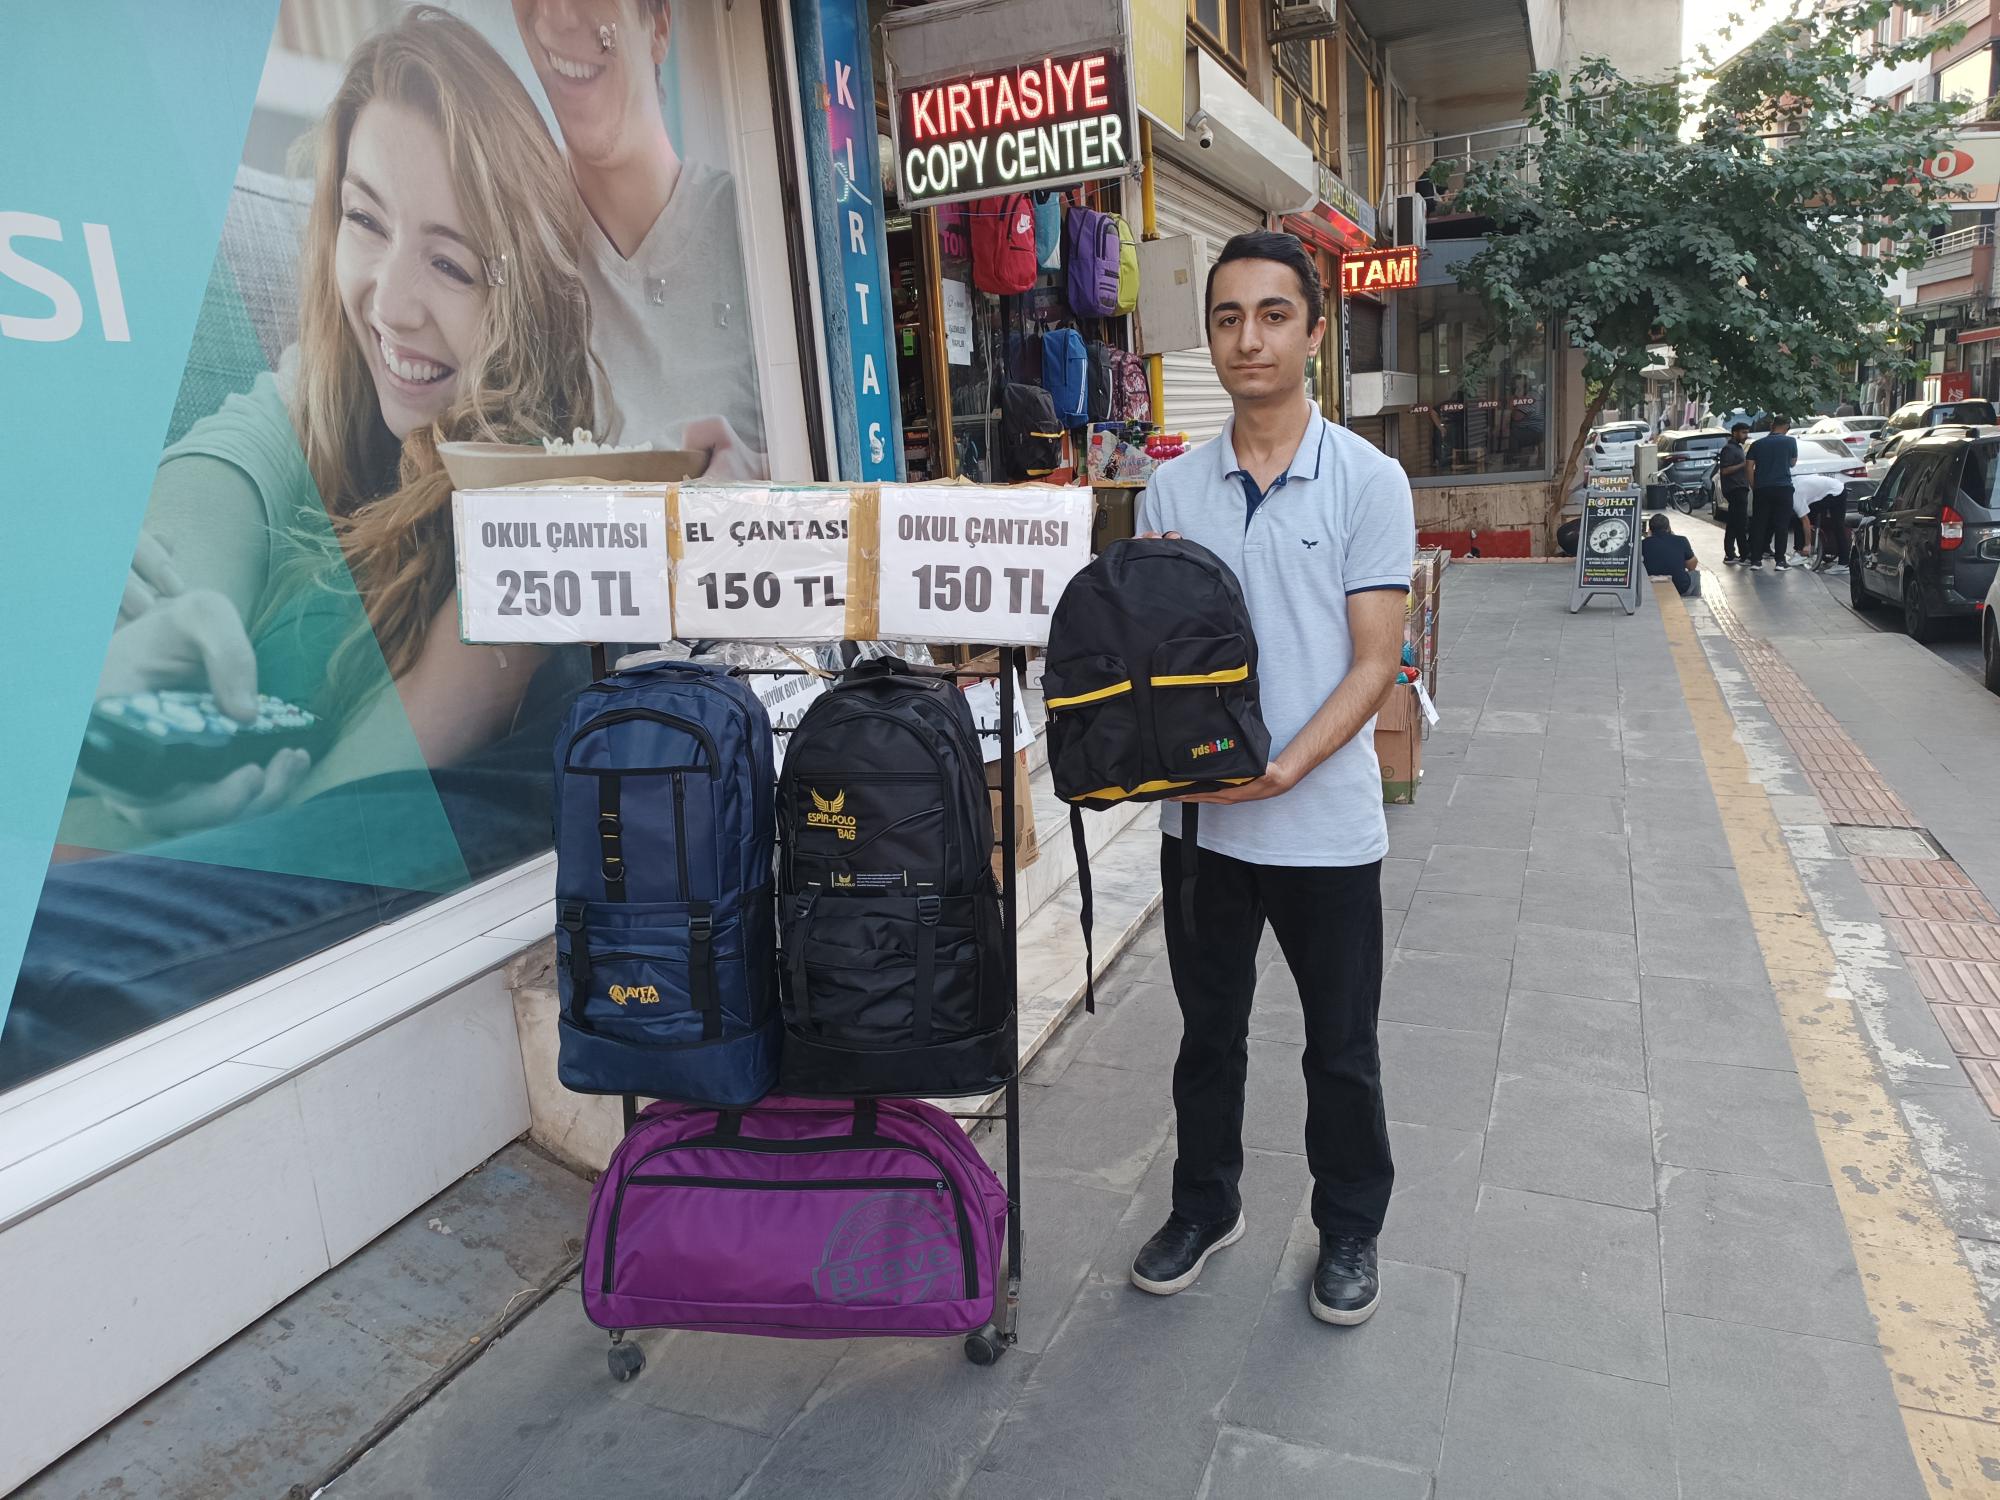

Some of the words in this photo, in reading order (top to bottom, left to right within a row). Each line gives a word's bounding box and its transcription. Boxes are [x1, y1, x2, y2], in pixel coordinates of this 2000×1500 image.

[911, 57, 1108, 138] KIRTASİYE
[906, 136, 989, 195] COPY
[996, 113, 1125, 180] CENTER
[1587, 497, 1635, 508] ROJHAT
[1596, 508, 1626, 516] SAAT
[481, 522, 541, 548] OKUL
[546, 522, 648, 553] ÇANTASI
[685, 522, 714, 542] EL
[729, 520, 848, 547] ÇANTASI
[898, 514, 959, 542] OKUL
[965, 517, 1069, 548] ÇANTASI
[496, 570, 581, 616] 250
[591, 571, 640, 616] TL
[697, 571, 781, 609] 150
[794, 575, 846, 607] TL
[911, 564, 992, 613] 150
[1003, 567, 1050, 614] TL
[784, 678, 800, 699] BOY
[838, 828, 856, 841] BAG
[830, 1245, 950, 1295] Brave
